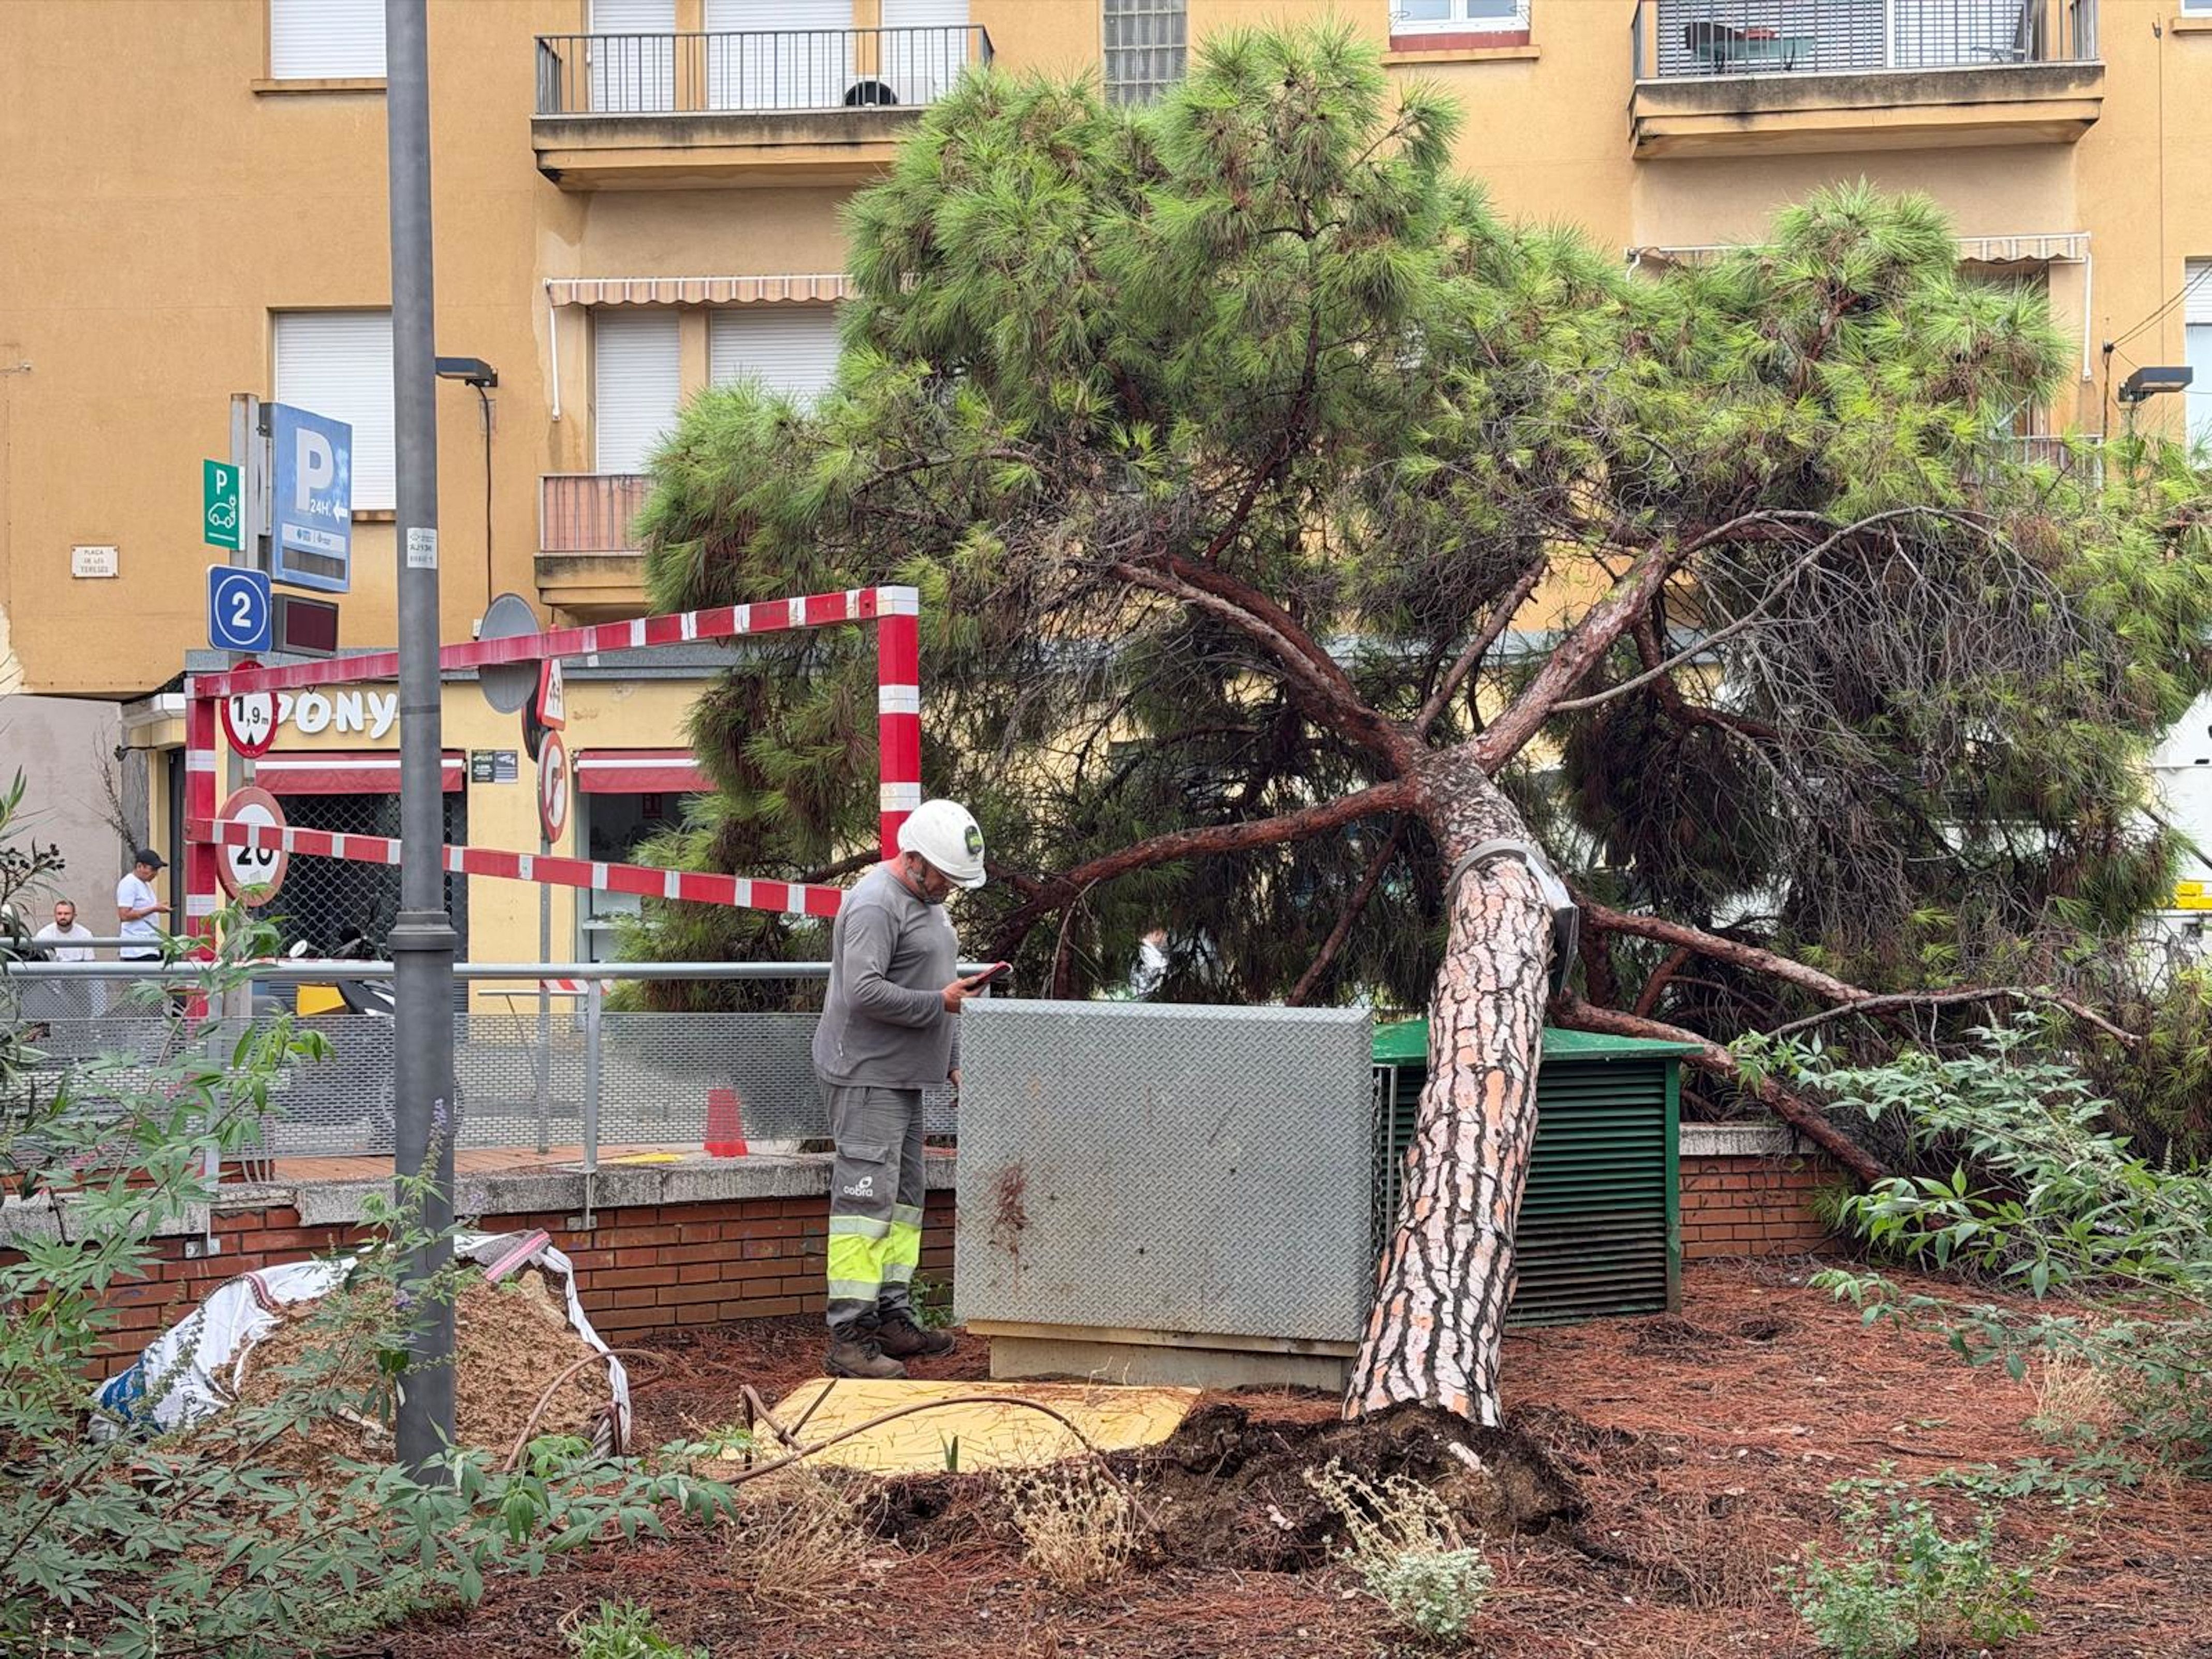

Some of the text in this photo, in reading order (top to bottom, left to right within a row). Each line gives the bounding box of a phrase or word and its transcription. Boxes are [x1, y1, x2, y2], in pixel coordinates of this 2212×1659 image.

[215, 469, 228, 495] P
[296, 427, 334, 512] P
[231, 591, 252, 628] 2
[843, 1184, 874, 1197] cobra
